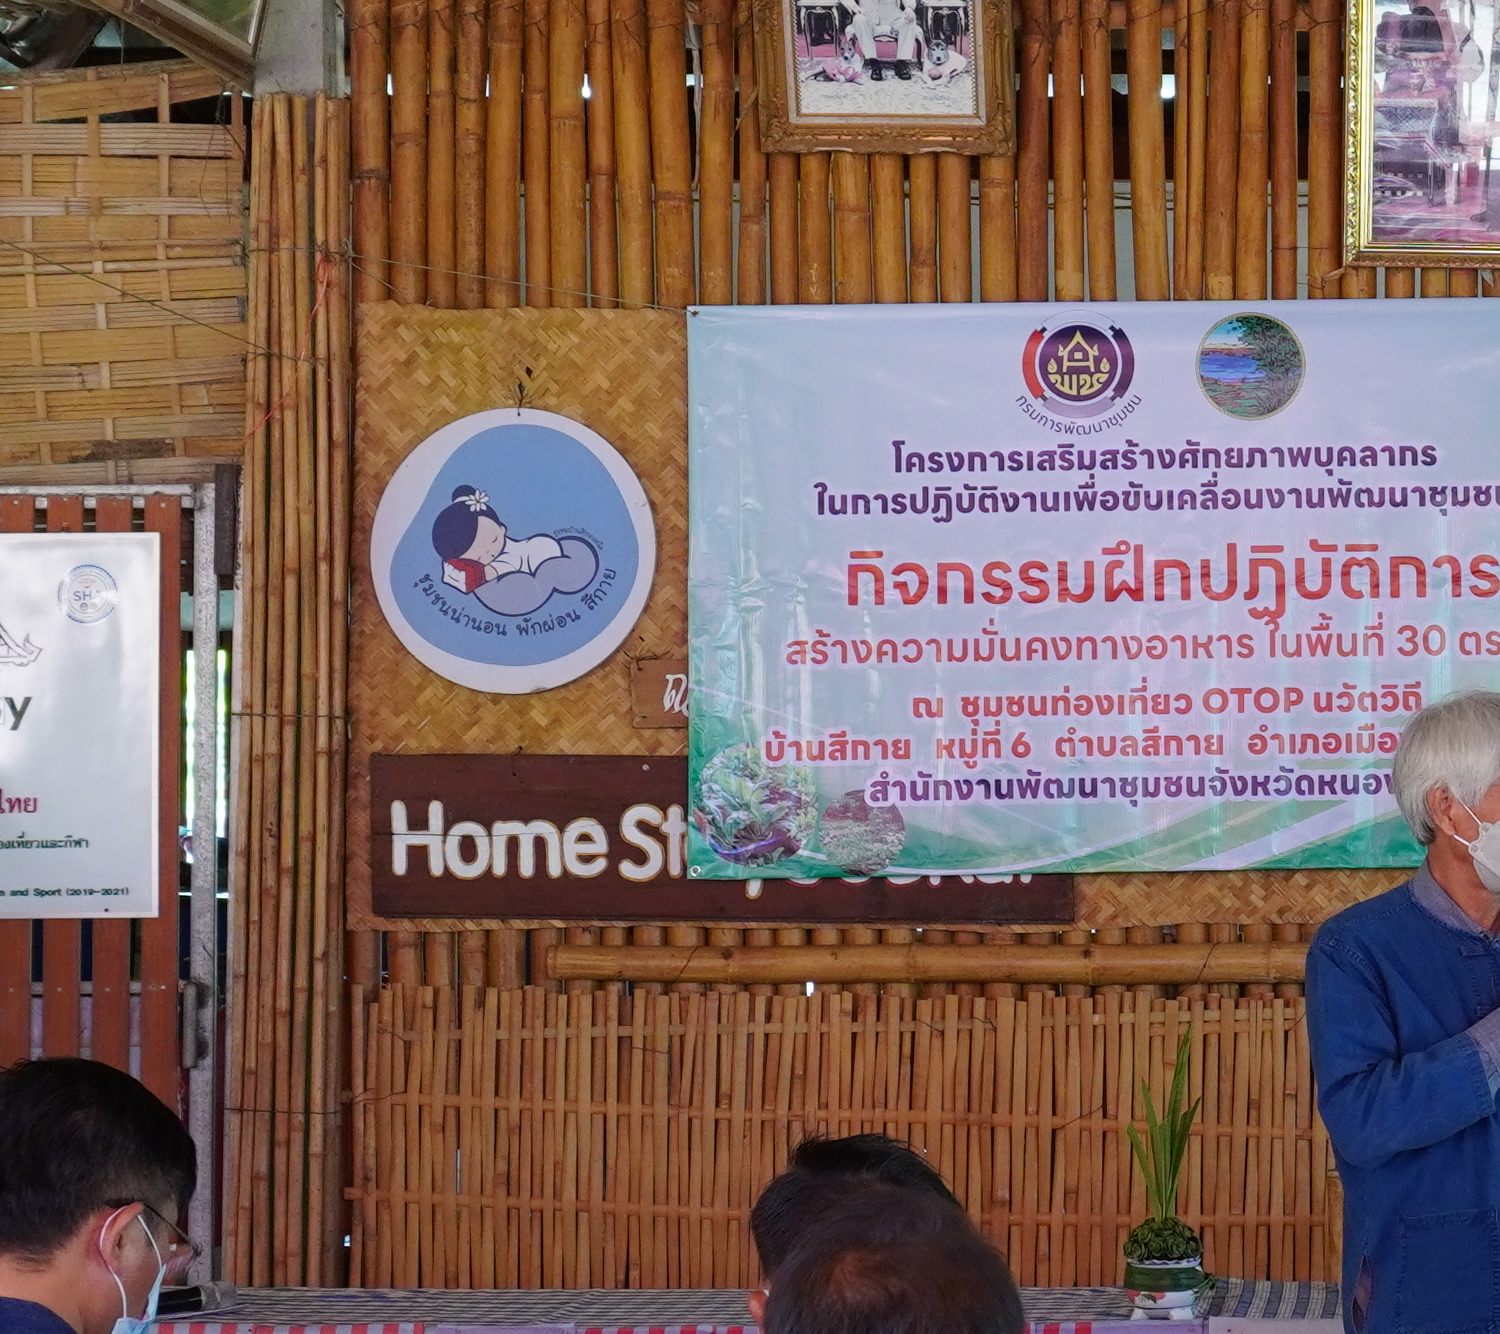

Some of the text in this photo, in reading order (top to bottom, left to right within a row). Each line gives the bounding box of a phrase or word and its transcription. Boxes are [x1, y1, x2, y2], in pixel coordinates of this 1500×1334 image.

[1016, 394, 1142, 436] กรมการพัฒนาชุมชน
[892, 439, 1438, 476] โครงการเสริมสร้างศักยภาพบุคลากร
[414, 568, 617, 637] ชุมชนน่านอน พักผ่อน สีกาย
[786, 619, 1255, 667] สร้างความมั่นคงทางอาหาร
[1269, 612, 1386, 659] ในพื้นที่
[1396, 624, 1447, 656] 30
[912, 680, 1423, 730] ณ ชุมชนท่องเที่ยว OTOP นวัตวิถี
[764, 721, 1403, 771] บ้านสีกาย หมู่ที่ 6 ตำบลสีกาย อำเภอเมือ
[868, 767, 1397, 810] สำนักงานพัฒนาชุมชนจังหวัดหนอ
[390, 800, 609, 881] Home
[10, 888, 29, 898] and
[33, 888, 62, 900] Sport
